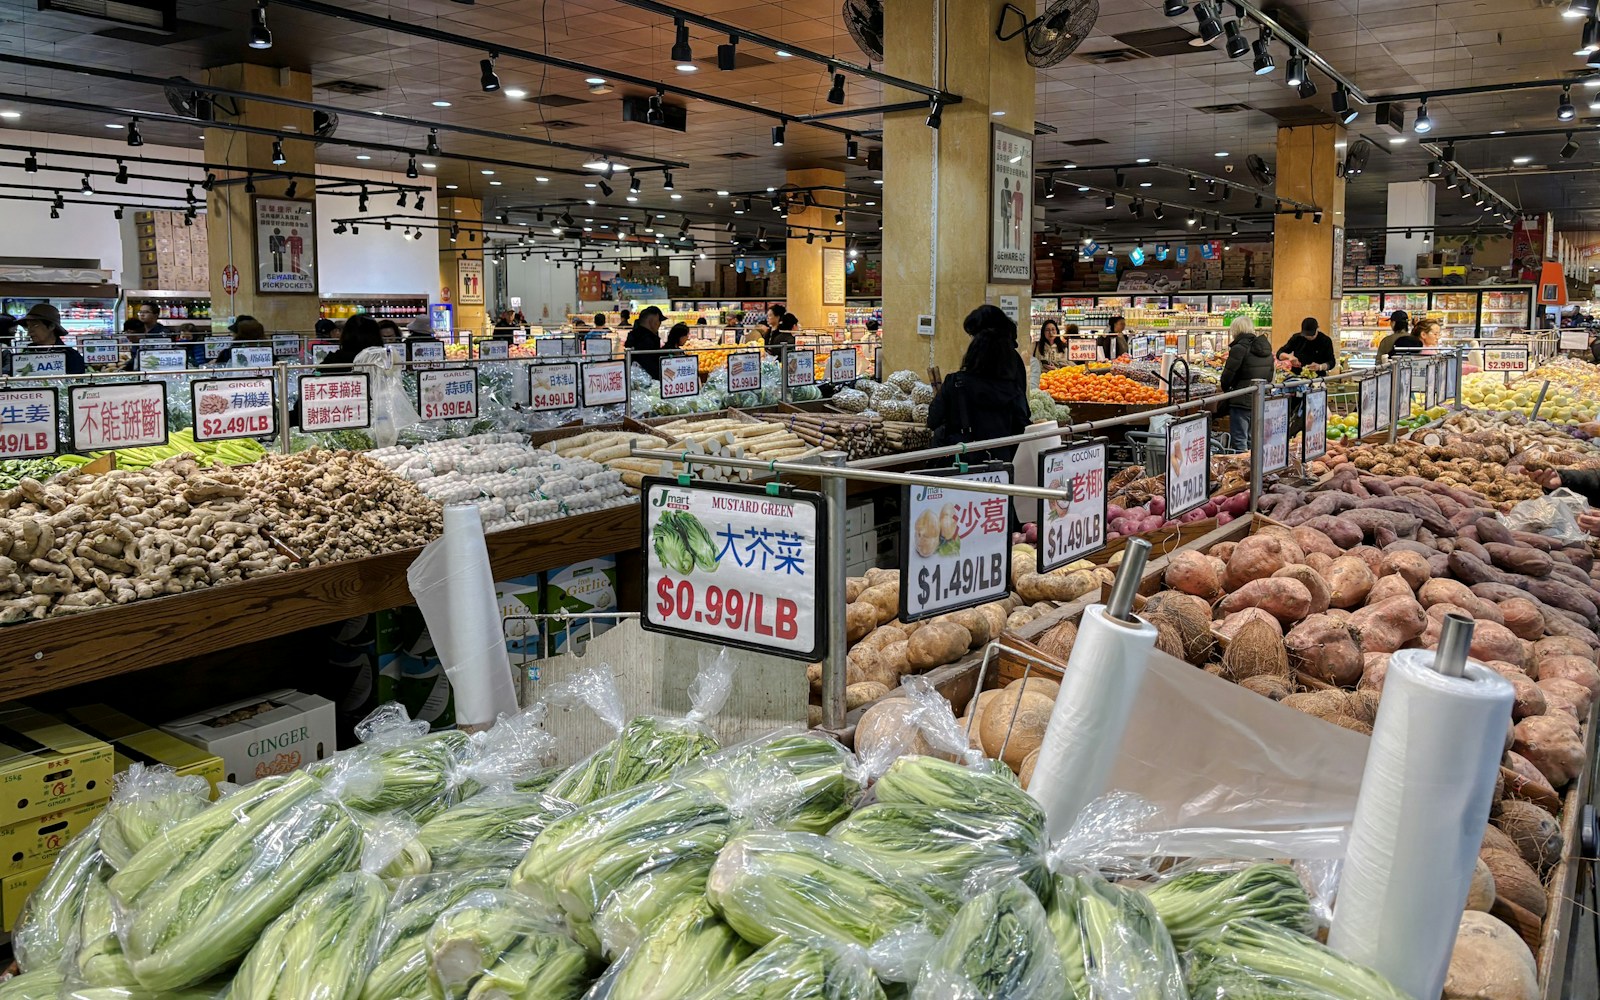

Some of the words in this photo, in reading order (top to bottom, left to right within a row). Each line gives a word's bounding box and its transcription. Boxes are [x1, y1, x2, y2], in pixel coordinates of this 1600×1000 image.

[997, 251, 1018, 262] BEWARE
[1019, 253, 1026, 262] OF
[994, 264, 1028, 275] PICKPOCKETS
[1488, 362, 1524, 370] $2.99/LB
[304, 381, 362, 400] 請不要摘掉
[445, 380, 473, 396] 蒜頭
[664, 381, 695, 396] $2.99/LB
[732, 376, 758, 389] $2.99/LB
[425, 400, 473, 419] $1.99/EA
[534, 392, 574, 408] $4.99/LB
[203, 415, 269, 437] $2.49/LB
[1071, 448, 1100, 463] COCONUT
[1170, 474, 1204, 513] $0.79/LB
[712, 496, 759, 513] MUSTARD
[761, 503, 794, 518] GREEN
[952, 498, 1007, 540] 沙葛
[1047, 513, 1100, 562] $1.49/LB
[714, 522, 805, 576] 大芥菜
[566, 578, 607, 596] Garlic
[918, 552, 1002, 609] $1.49/LB
[656, 575, 798, 640] $0.99/LB
[247, 726, 310, 758] GINGER
[4, 774, 22, 784] 15kg
